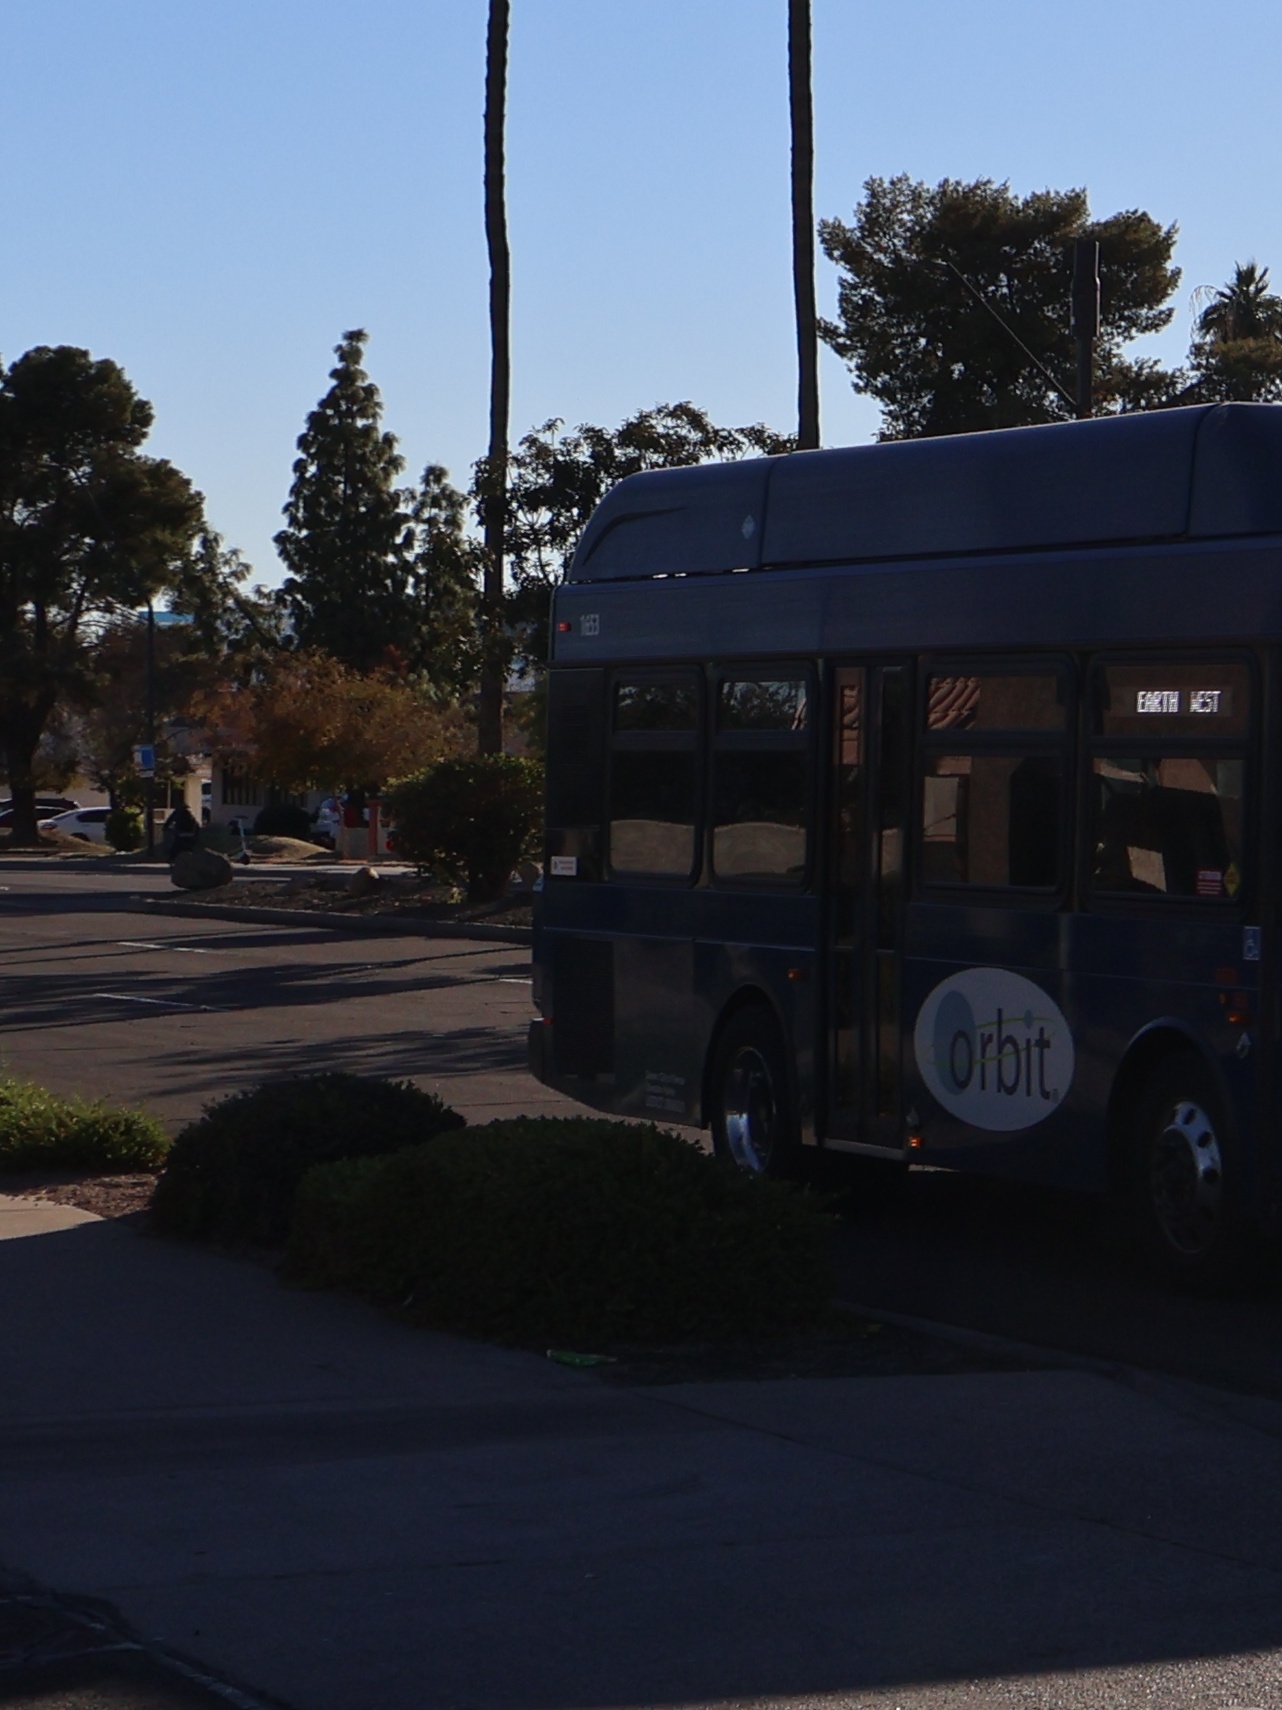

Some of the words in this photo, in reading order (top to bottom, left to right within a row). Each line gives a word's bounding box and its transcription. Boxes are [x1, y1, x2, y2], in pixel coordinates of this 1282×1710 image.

[1136, 690, 1180, 713] EARTH
[1189, 690, 1222, 713] WEST
[951, 1007, 1052, 1100] orbit
